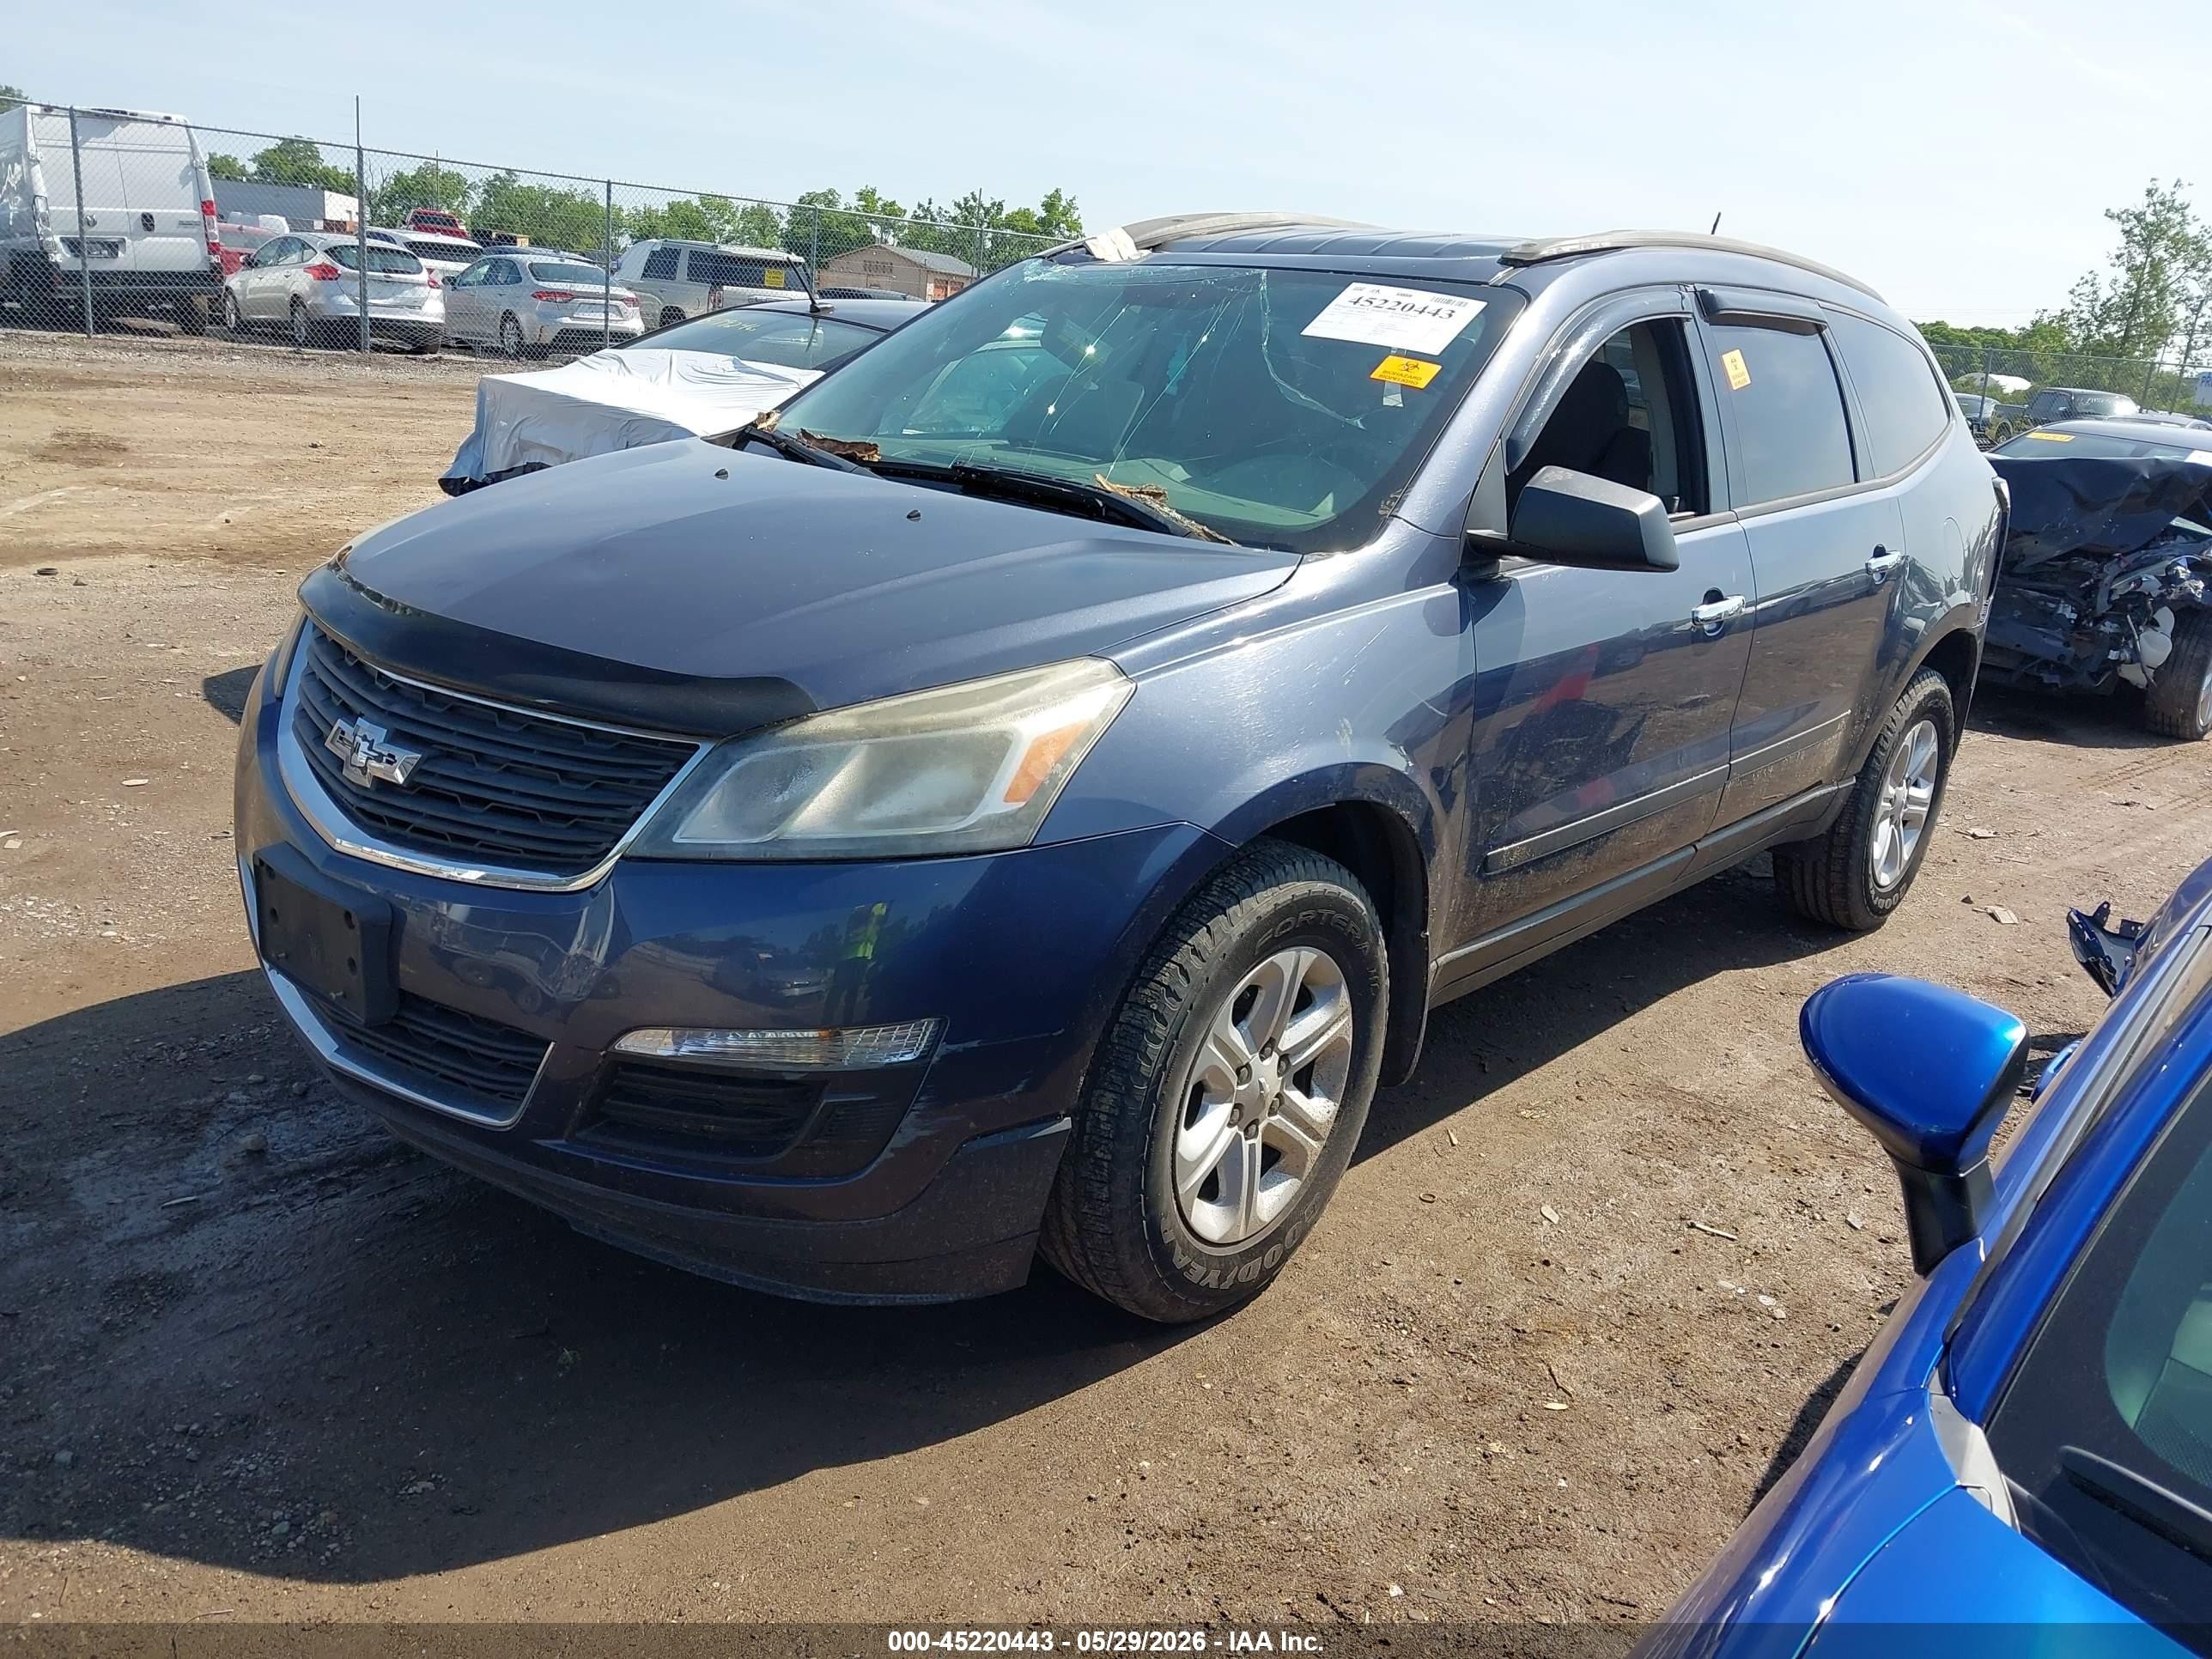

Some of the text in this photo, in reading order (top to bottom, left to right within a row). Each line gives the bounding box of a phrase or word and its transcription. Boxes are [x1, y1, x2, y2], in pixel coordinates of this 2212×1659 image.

[1348, 295, 1456, 319] 45220443
[1377, 374, 1419, 386] BIOPELIGRO
[1382, 369, 1423, 382] BIOHAZARD
[1160, 1192, 1323, 1290] GOODYEAR
